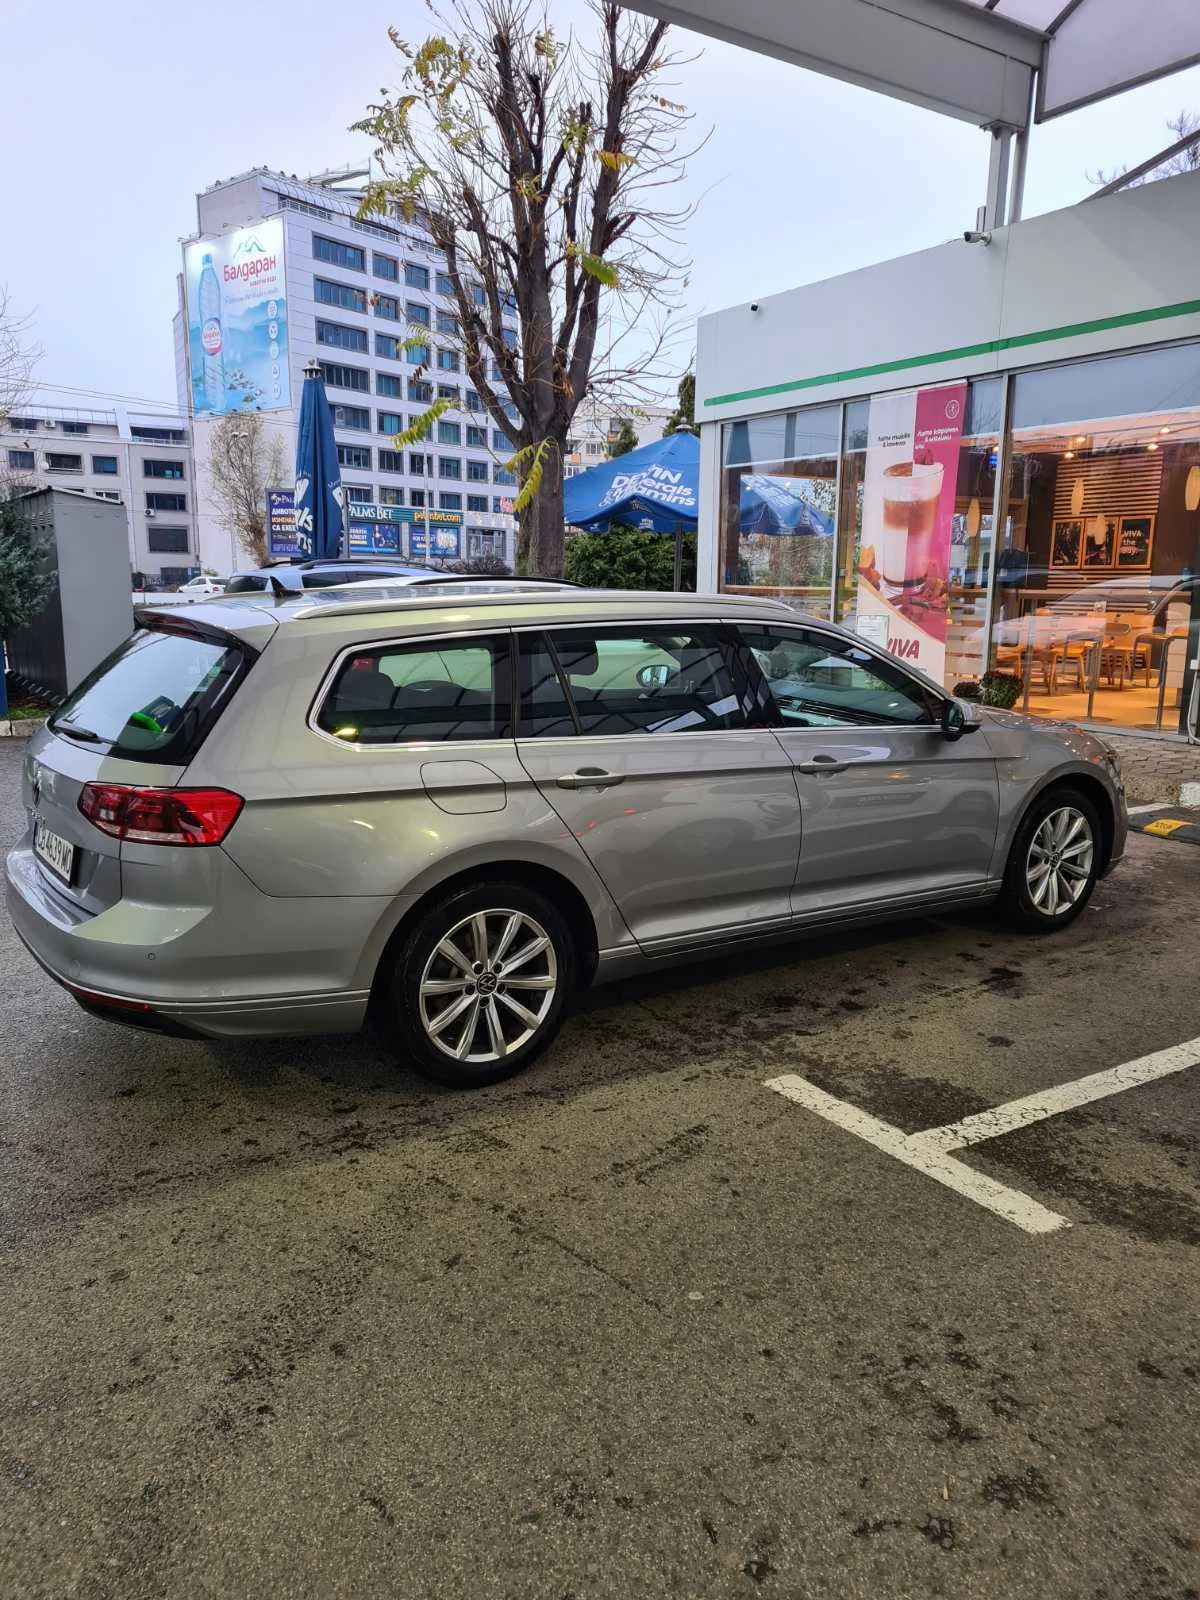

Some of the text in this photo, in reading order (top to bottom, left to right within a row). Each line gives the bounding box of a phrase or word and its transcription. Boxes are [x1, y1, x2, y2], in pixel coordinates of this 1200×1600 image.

[223, 256, 277, 282] Балдаран
[612, 464, 682, 489] DEIN
[414, 510, 461, 523] palsbet.com
